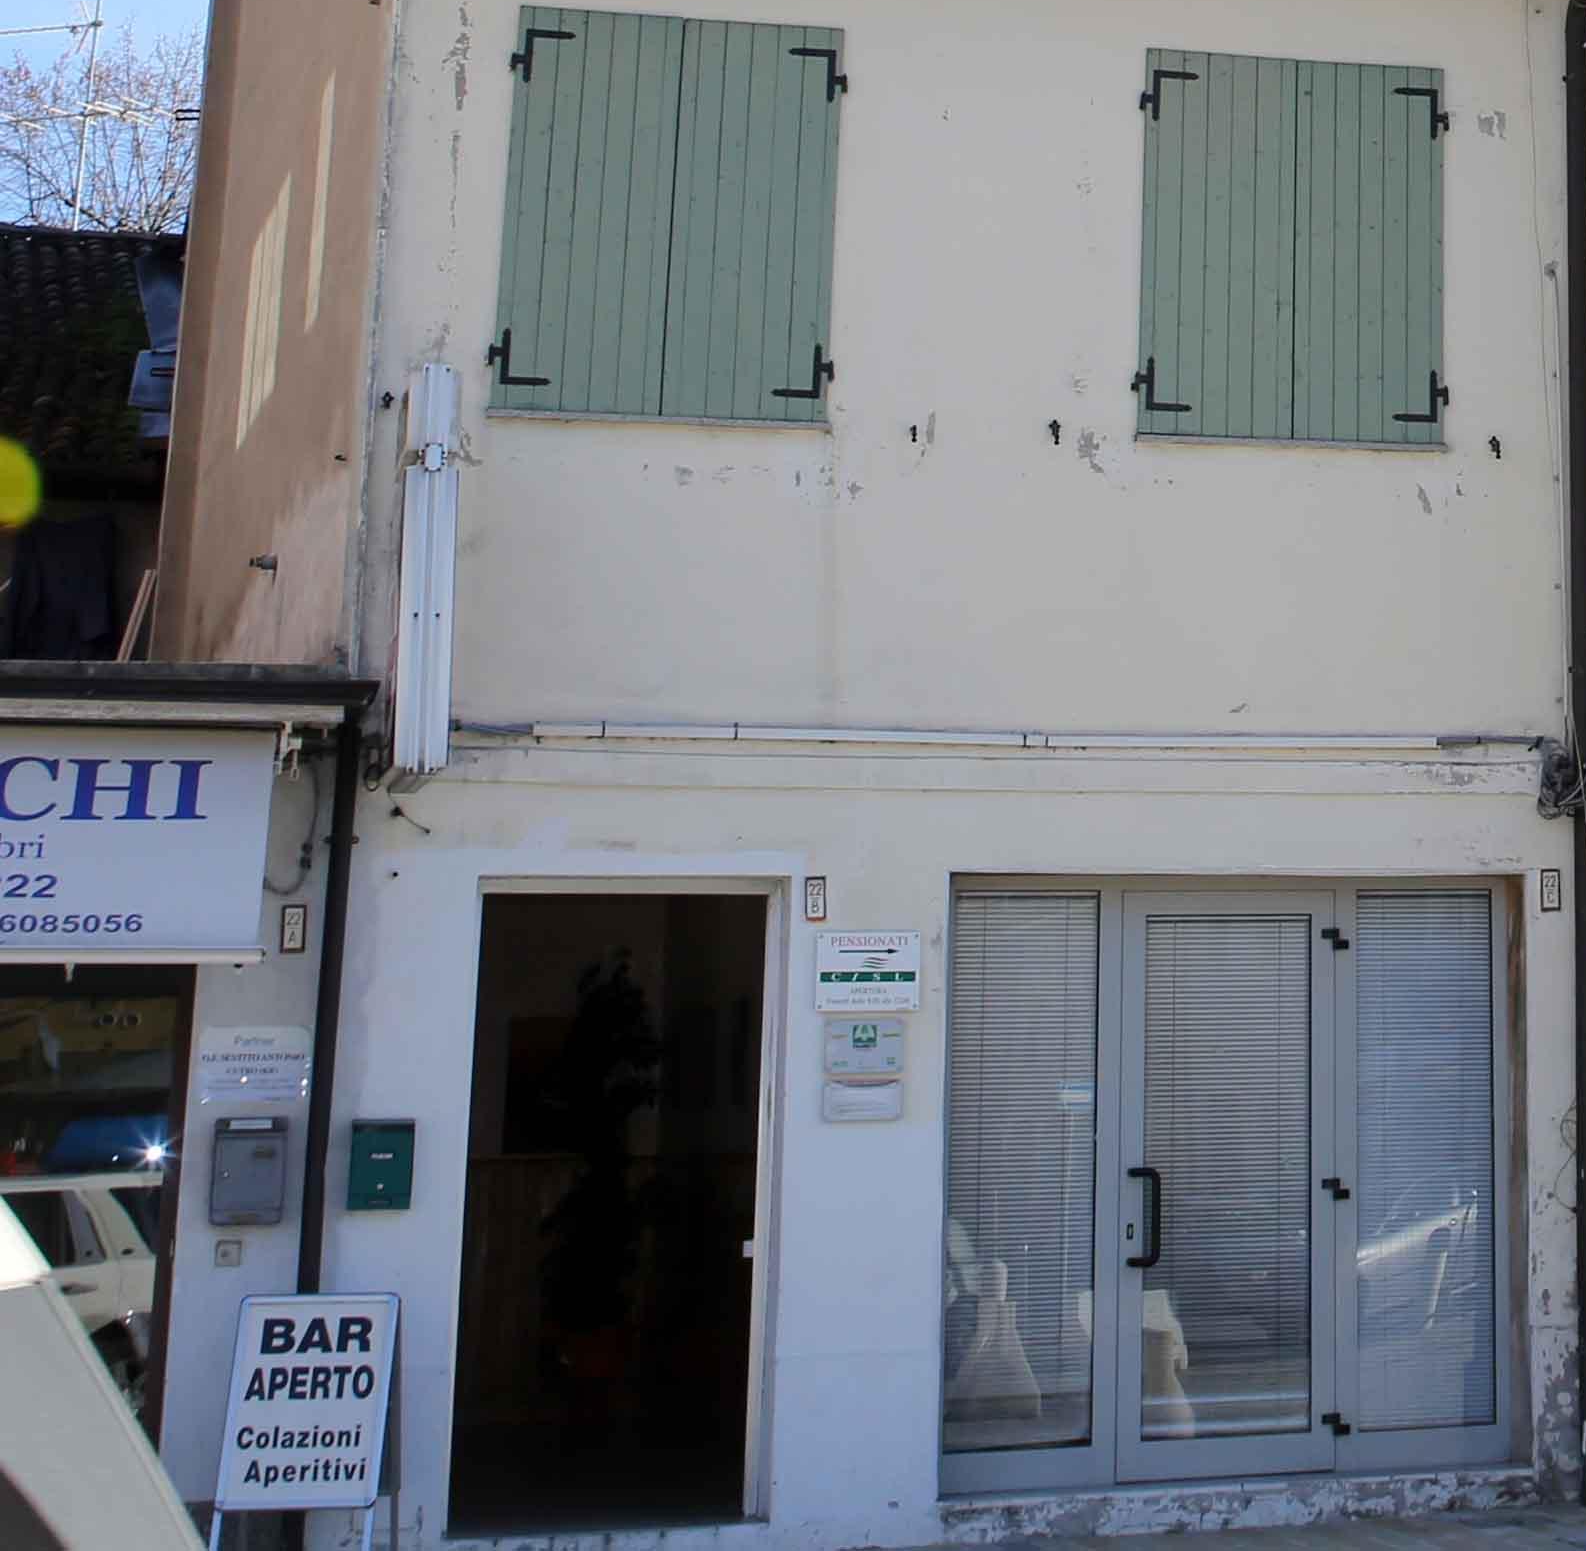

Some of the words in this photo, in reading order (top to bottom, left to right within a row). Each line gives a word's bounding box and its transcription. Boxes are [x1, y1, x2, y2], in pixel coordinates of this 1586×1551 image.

[0, 756, 214, 821] CHI
[0, 873, 58, 898] 22
[808, 882, 823, 896] 22
[0, 914, 144, 934] 6085056
[287, 911, 302, 926] 22
[831, 935, 909, 947] PENSIONATI
[259, 1317, 373, 1355] BAR
[243, 1365, 375, 1401] APERTO
[236, 1425, 363, 1451] Colazioni
[243, 1458, 367, 1488] Aperitivi
